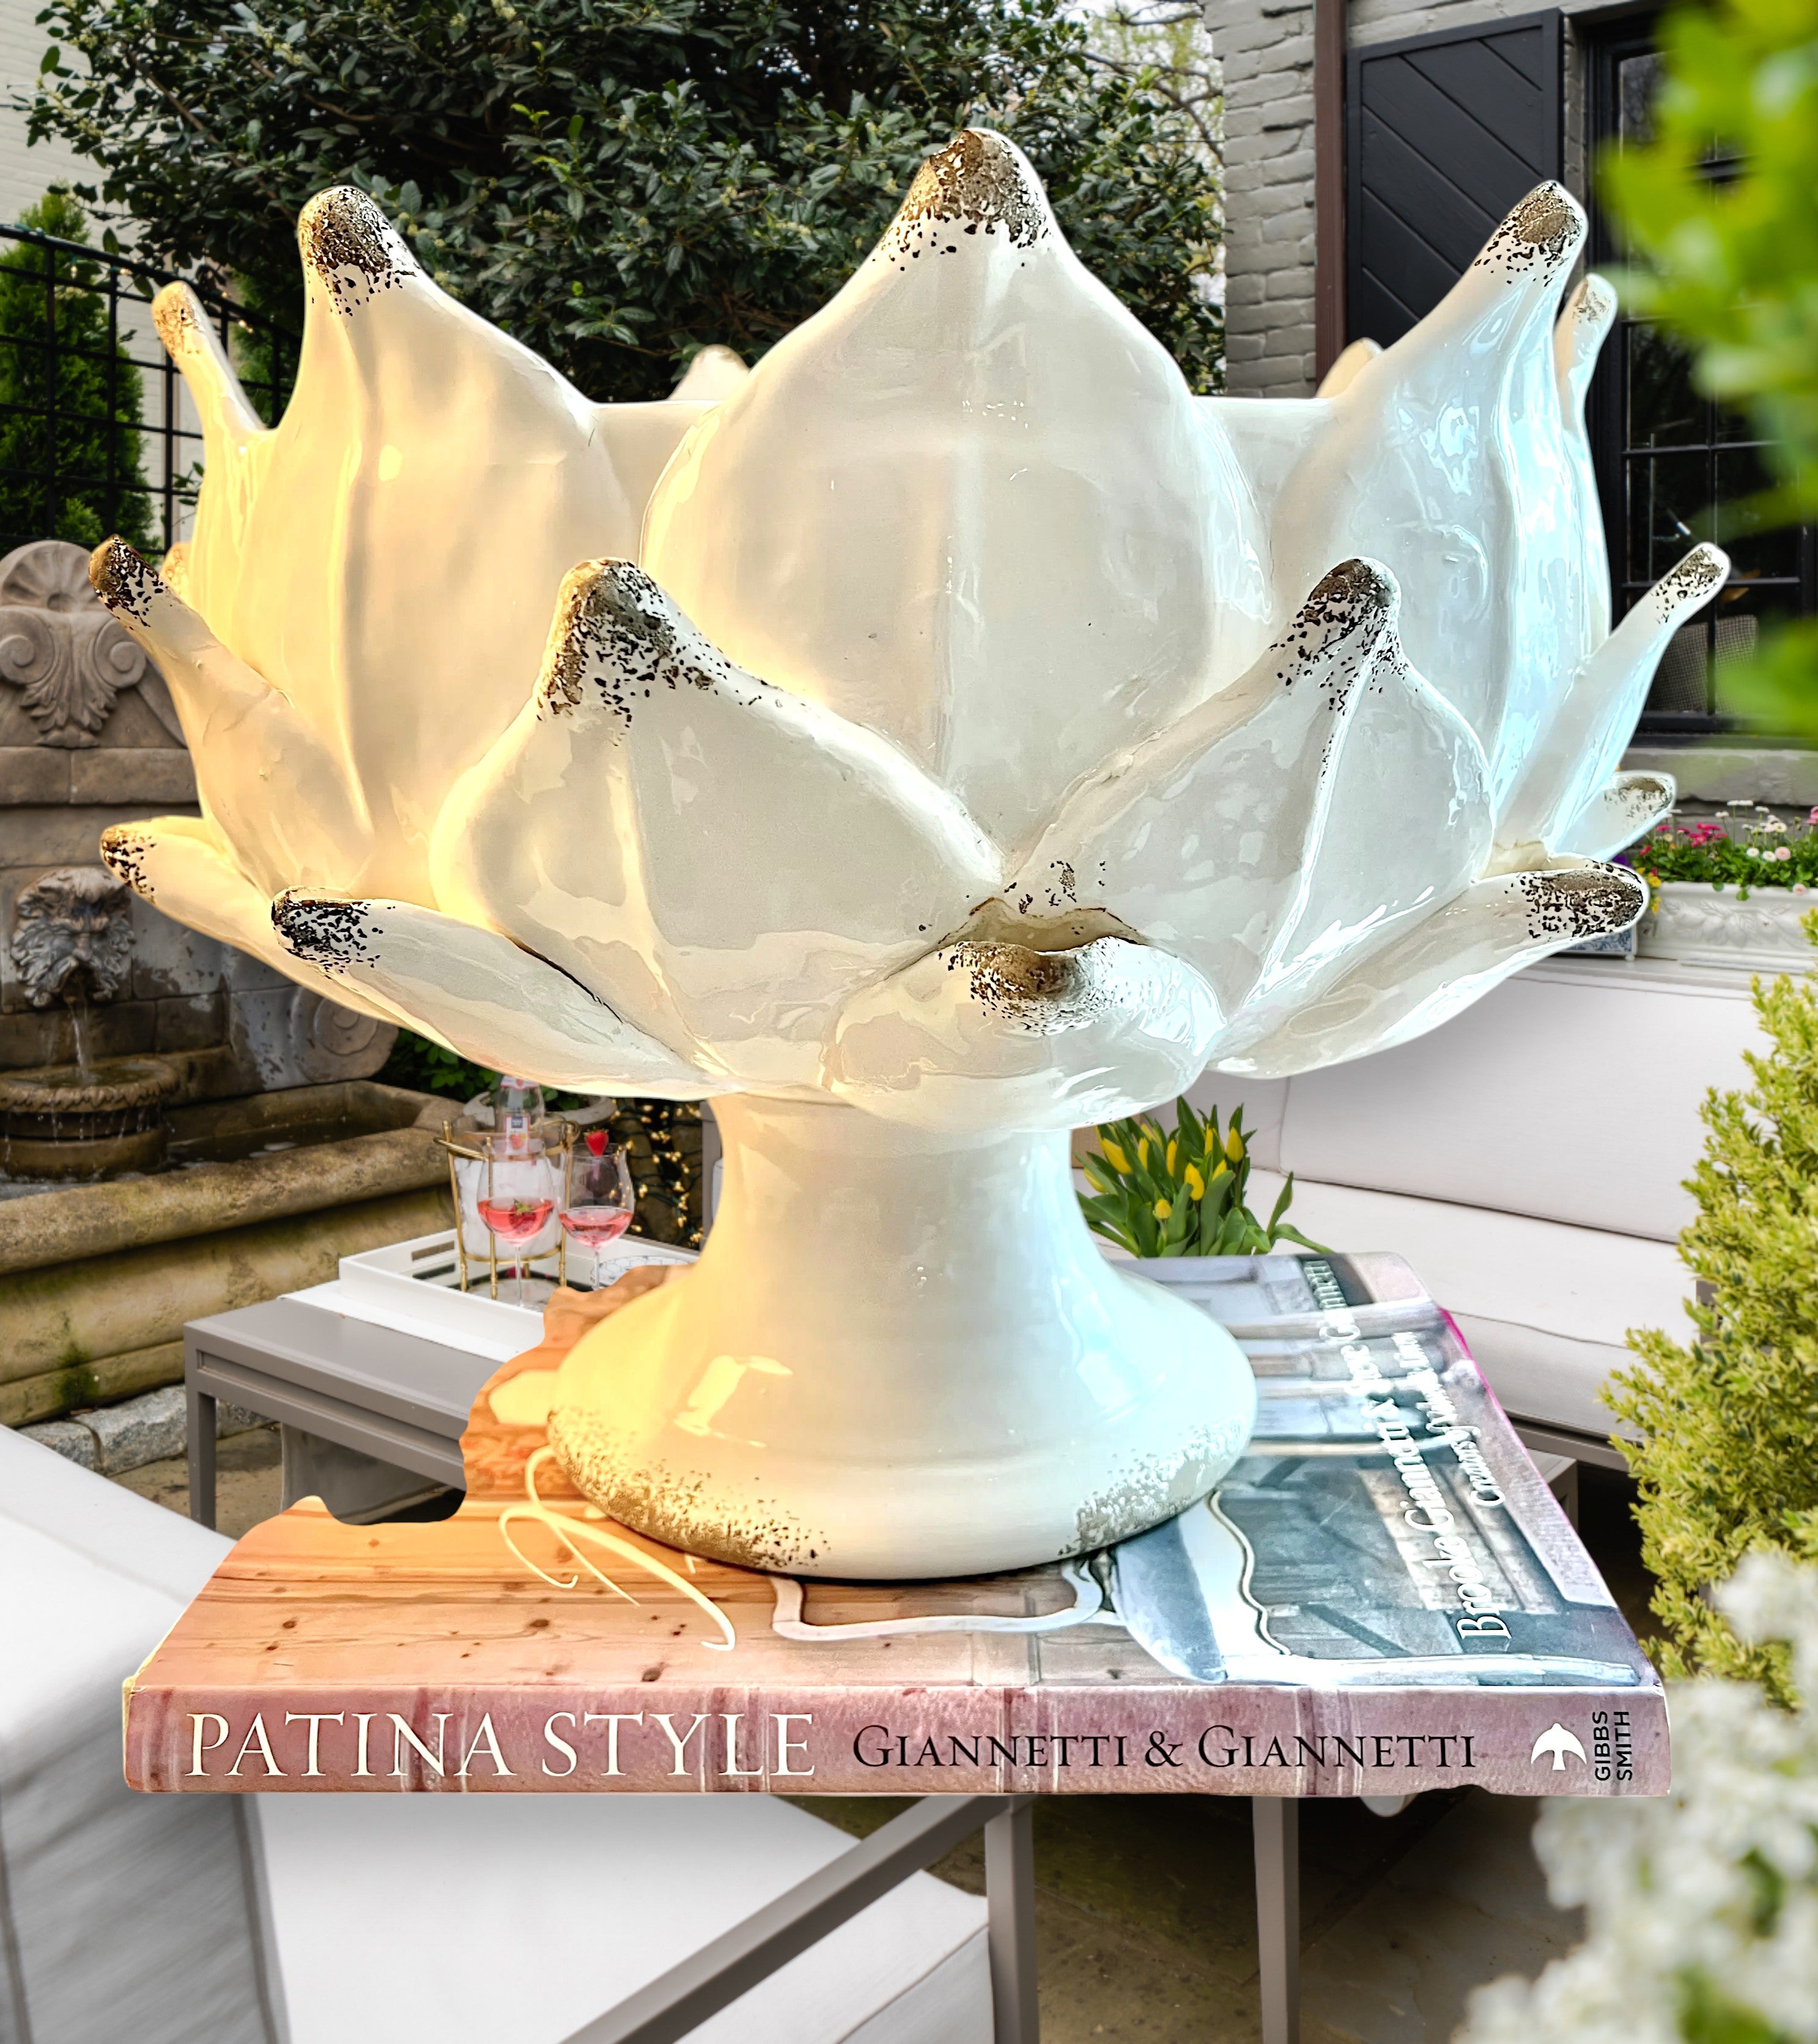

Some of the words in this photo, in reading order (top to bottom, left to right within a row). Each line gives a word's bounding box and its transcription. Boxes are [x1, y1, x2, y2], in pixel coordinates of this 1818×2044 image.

[1302, 1259, 1361, 1342] Gnnetti
[1363, 1420, 1455, 1531] Giannetti
[1450, 1441, 1506, 1507] Creators
[1422, 1536, 1512, 1640] Brooke
[185, 1712, 517, 1777] PATINA
[541, 1711, 815, 1778] STYLE
[852, 1724, 1128, 1769] GIANNETTI
[1144, 1728, 1183, 1769] &
[1197, 1724, 1476, 1769] GIANNETTI
[1592, 1711, 1611, 1781] GIBBS
[1613, 1711, 1633, 1781] SMITH
